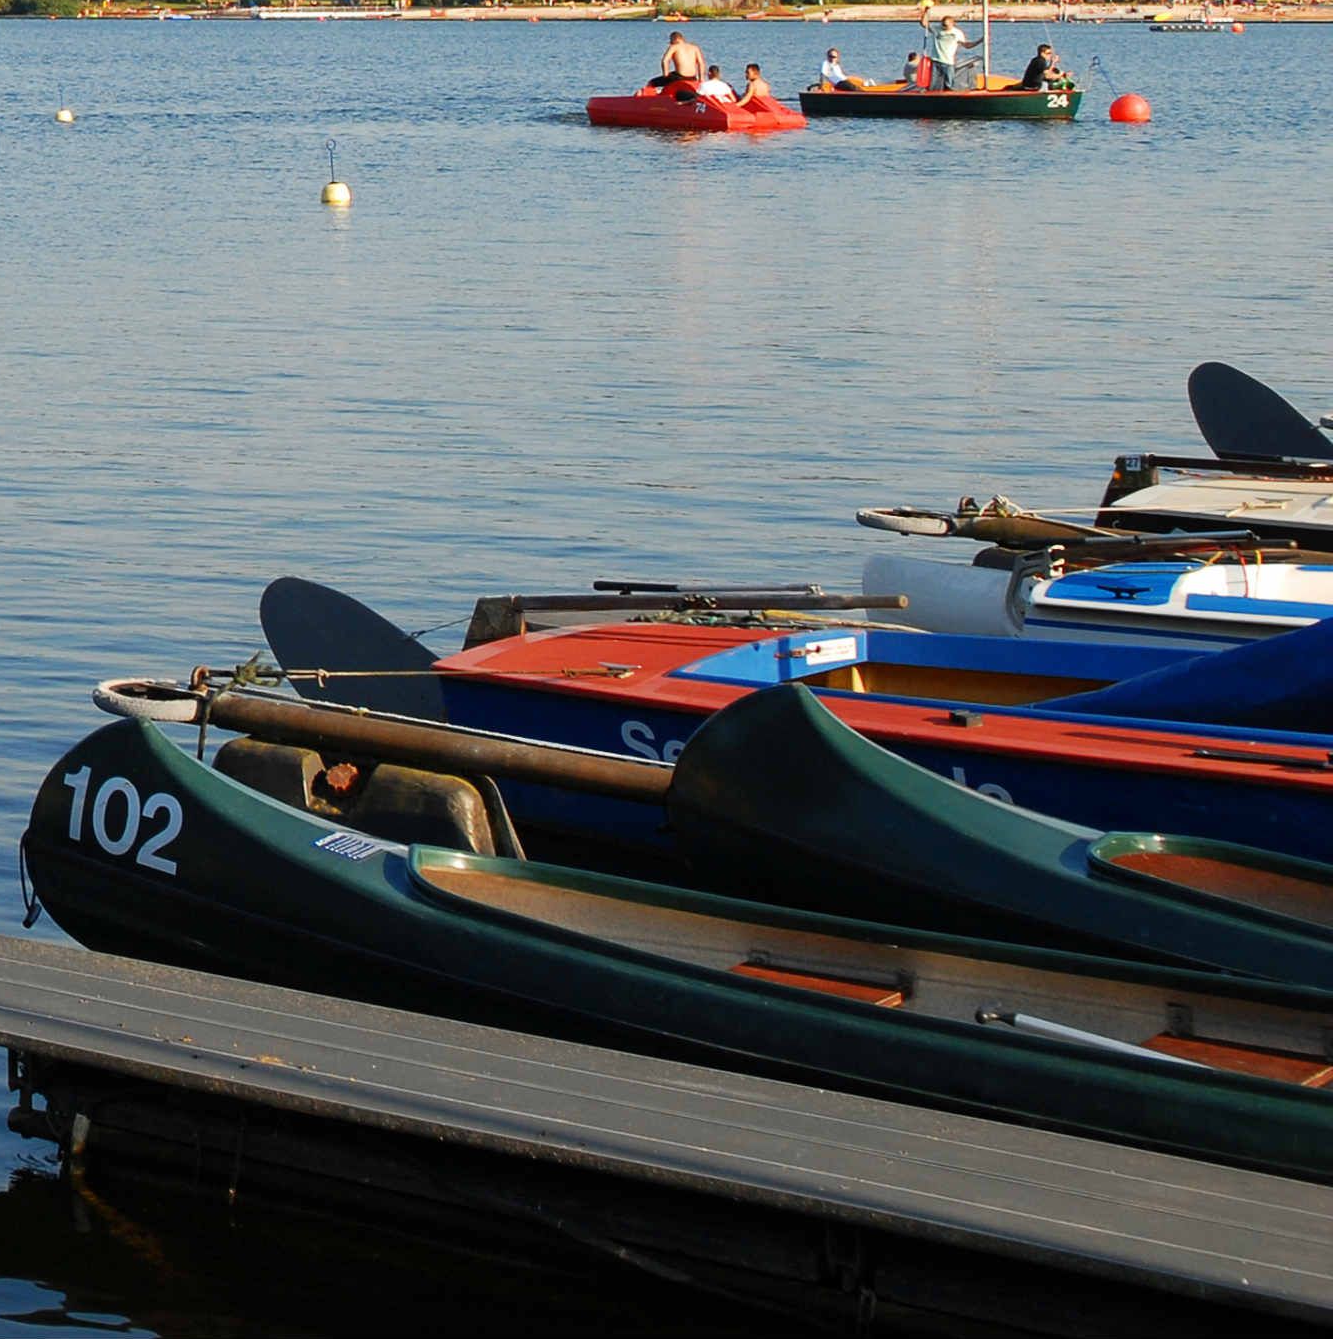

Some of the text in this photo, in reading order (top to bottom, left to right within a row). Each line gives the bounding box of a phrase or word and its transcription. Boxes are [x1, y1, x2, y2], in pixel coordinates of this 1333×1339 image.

[1047, 94, 1069, 108] 24
[695, 102, 707, 114] 74
[1126, 458, 1139, 469] 27
[63, 765, 183, 876] 102
